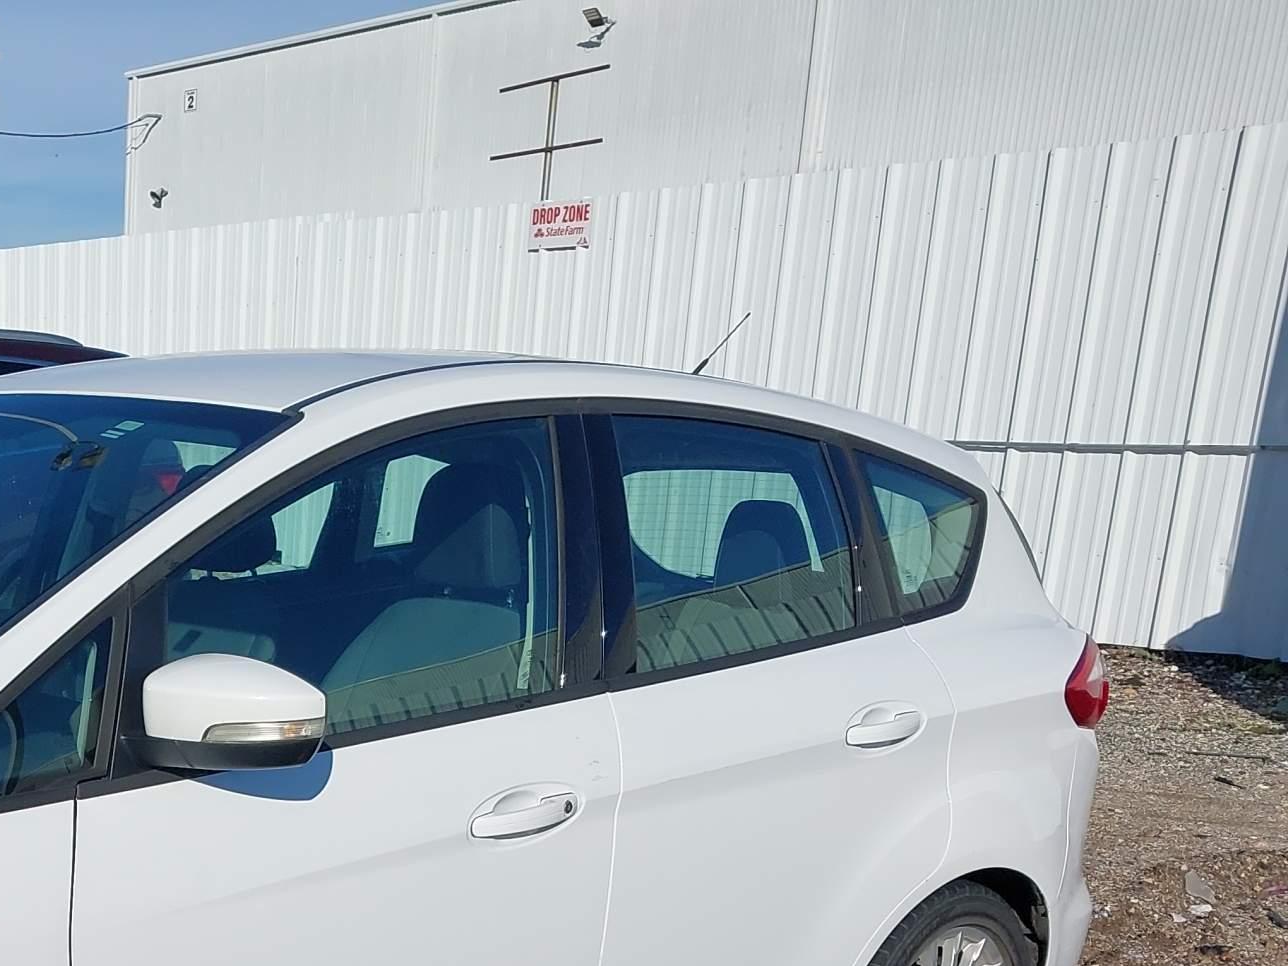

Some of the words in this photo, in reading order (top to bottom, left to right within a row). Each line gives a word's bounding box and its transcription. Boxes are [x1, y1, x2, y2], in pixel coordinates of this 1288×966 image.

[187, 96, 194, 109] 2
[532, 207, 561, 225] DROP
[562, 204, 591, 223] ZONE
